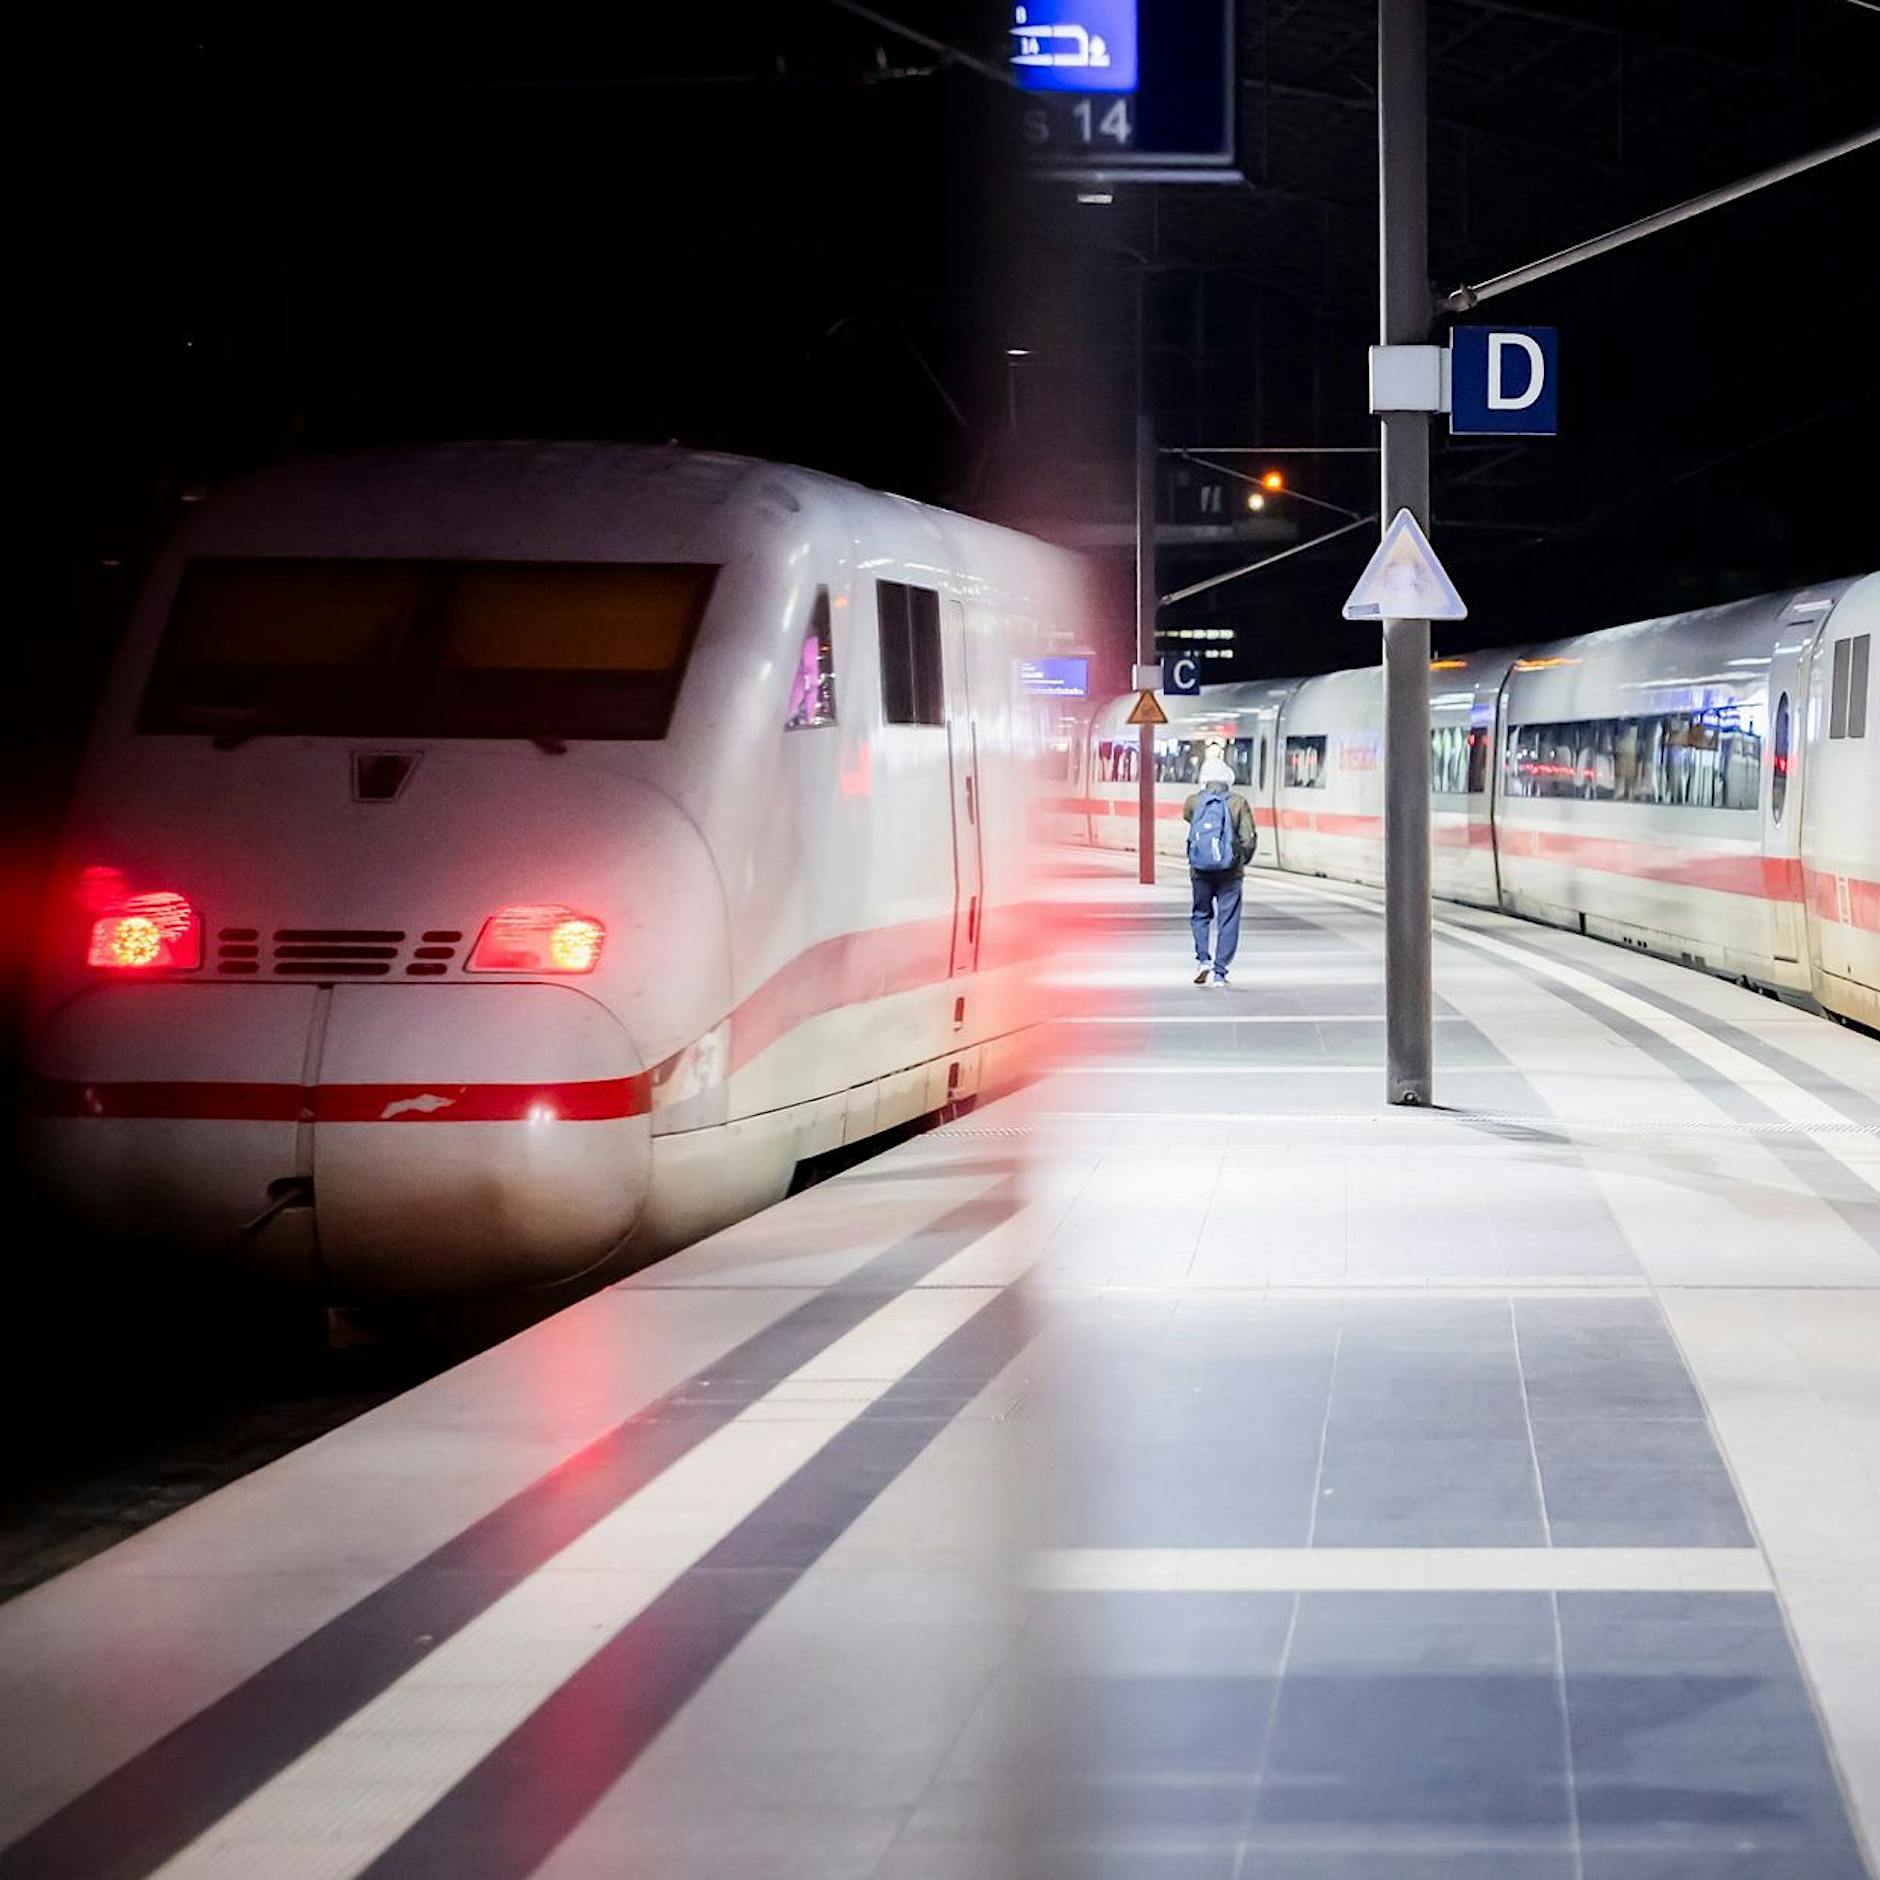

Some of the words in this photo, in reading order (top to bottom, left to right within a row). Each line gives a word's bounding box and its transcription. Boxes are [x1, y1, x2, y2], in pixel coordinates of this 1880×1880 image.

[1073, 98, 1132, 143] 14
[1488, 332, 1545, 410] D
[1174, 659, 1195, 689] C
